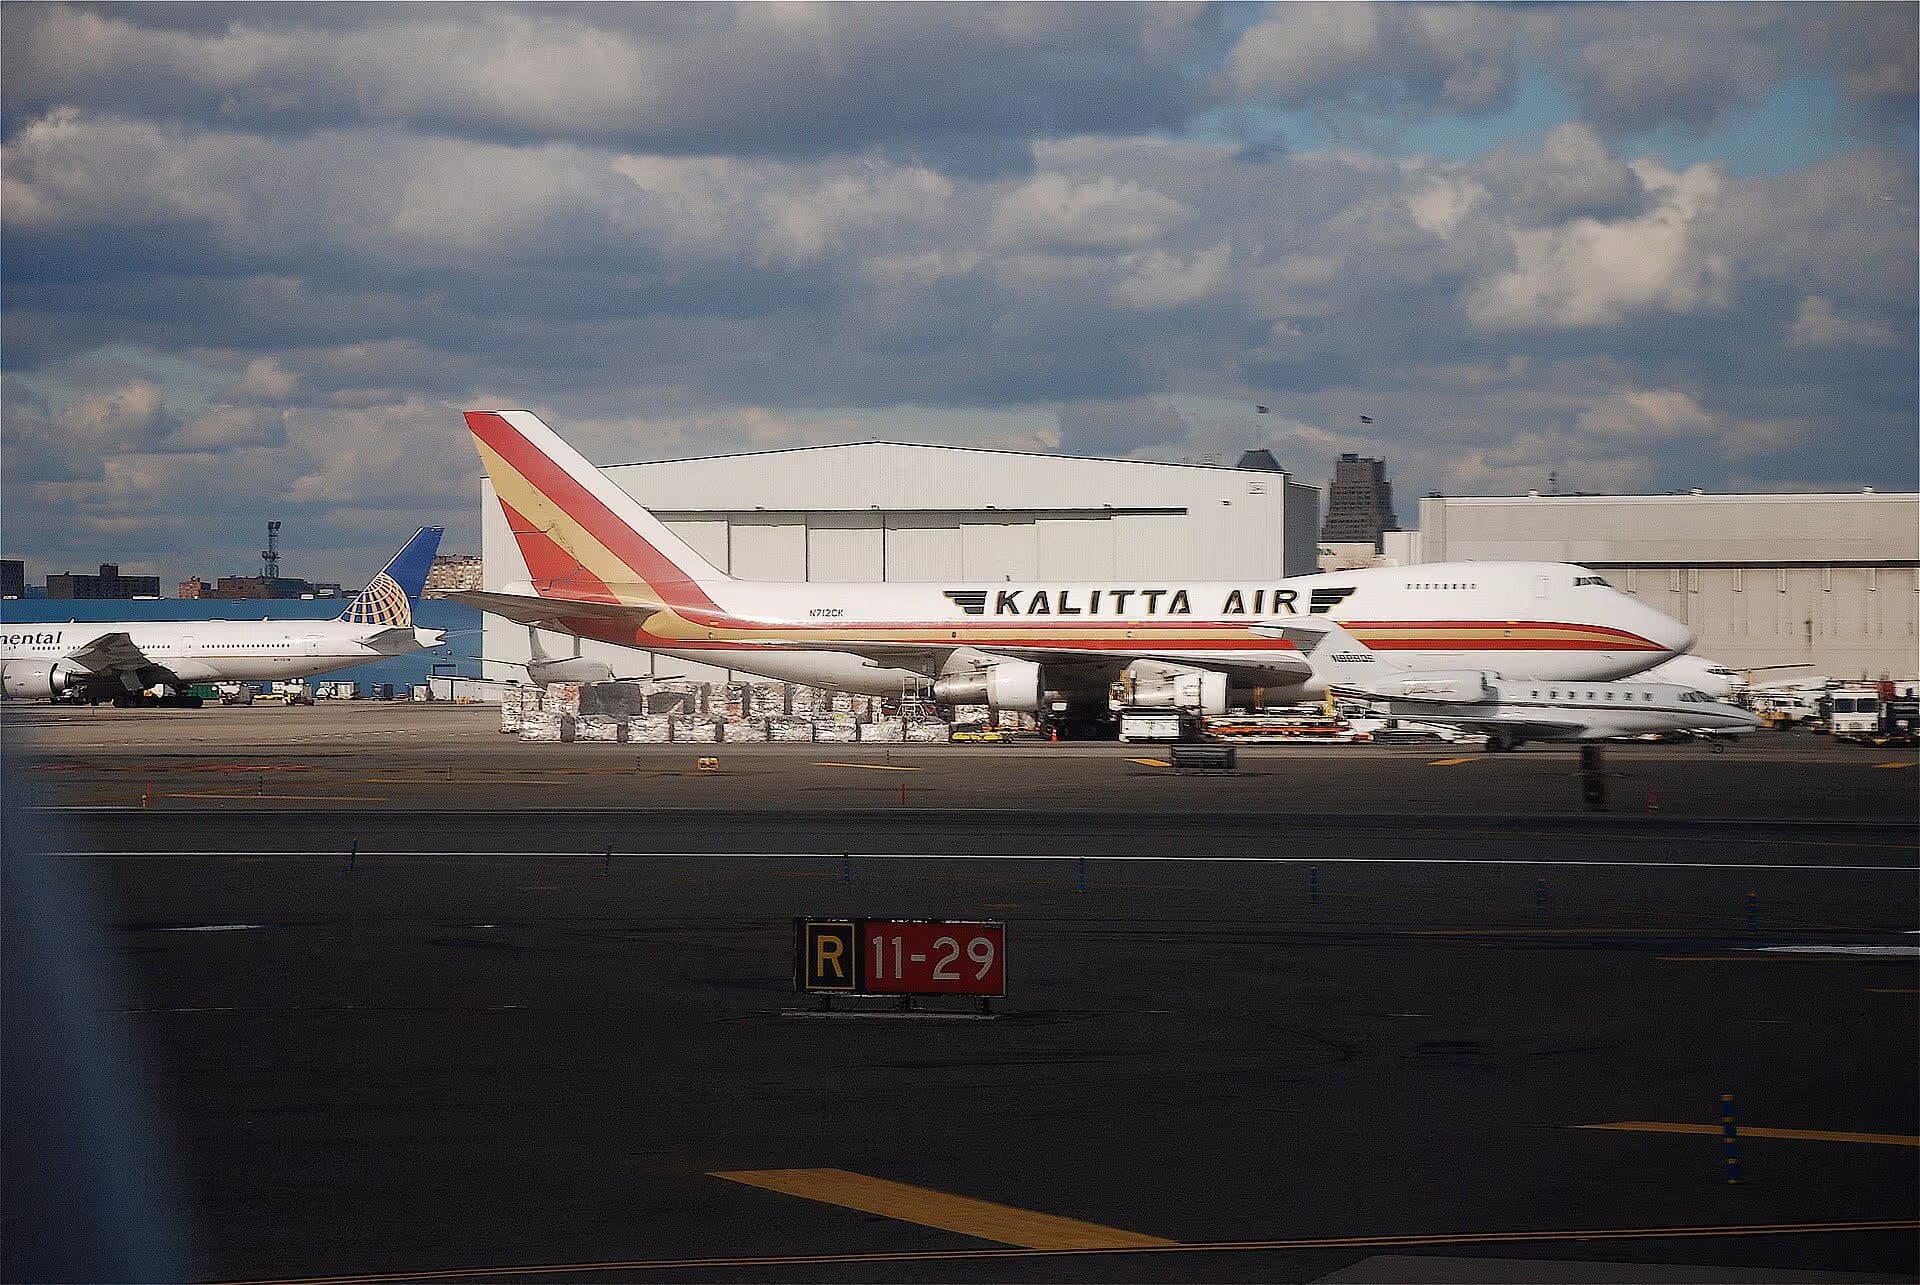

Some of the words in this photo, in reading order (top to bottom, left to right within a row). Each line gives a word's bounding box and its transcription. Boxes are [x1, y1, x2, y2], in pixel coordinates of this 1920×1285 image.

[809, 608, 844, 617] N712CK
[995, 589, 1191, 615] KALITTA
[1222, 589, 1298, 615] AIR
[817, 935, 844, 978] R
[872, 935, 995, 981] 11-29
